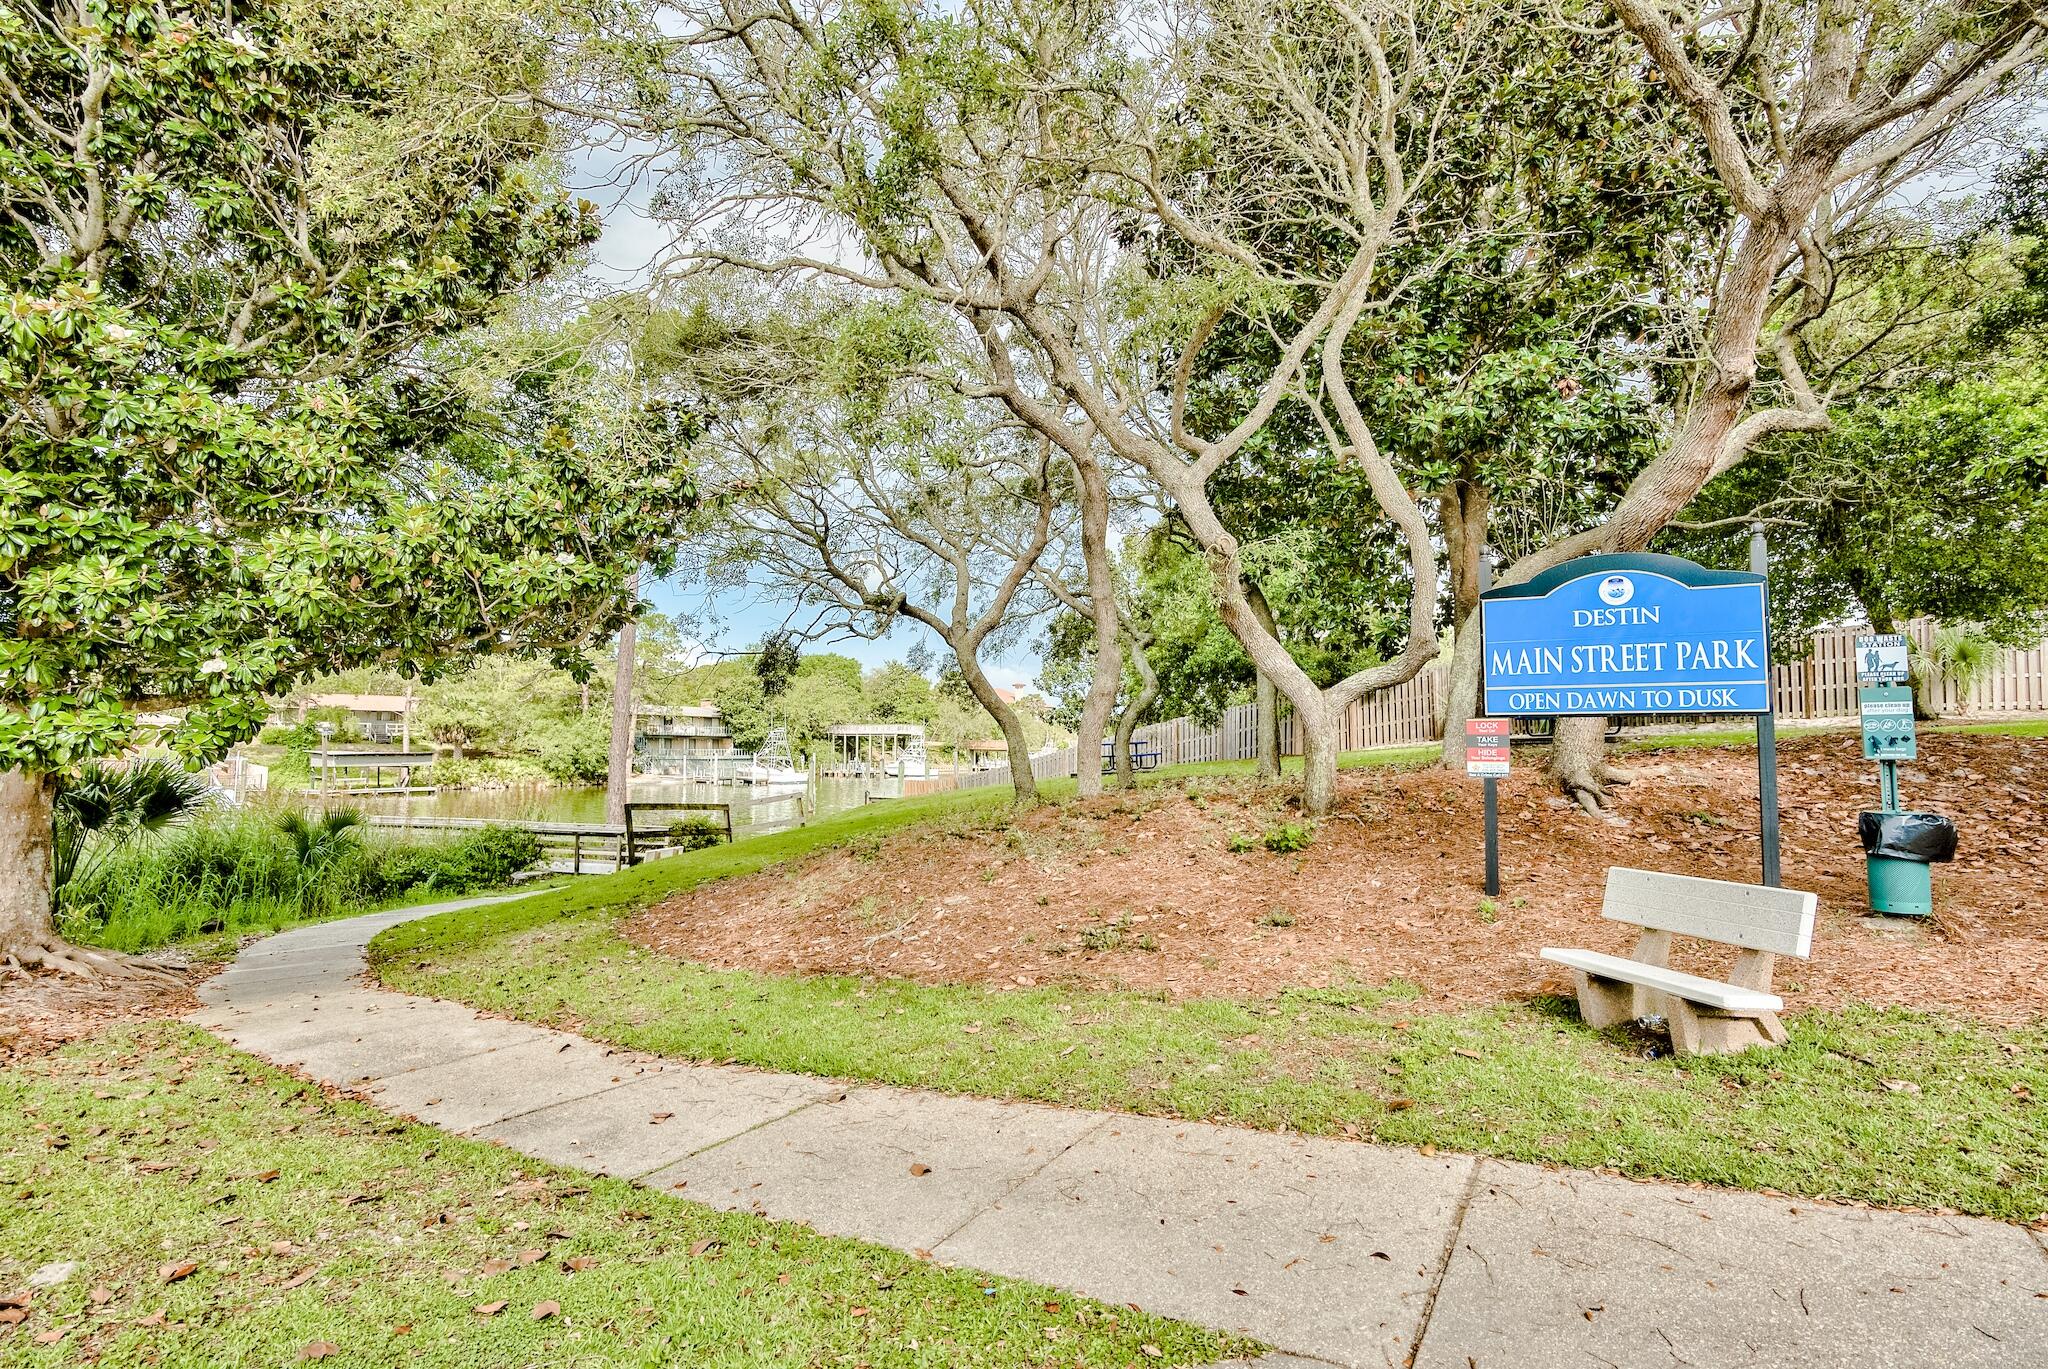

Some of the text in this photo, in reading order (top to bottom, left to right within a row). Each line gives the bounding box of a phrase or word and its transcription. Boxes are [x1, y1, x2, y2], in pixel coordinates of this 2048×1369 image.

[1572, 606, 1662, 627] DESTIN
[1876, 634, 1904, 642] WASTE
[1491, 639, 1759, 676] MAIN STREET PARK
[1508, 688, 1740, 710] OPEN DAWN TO DUSK
